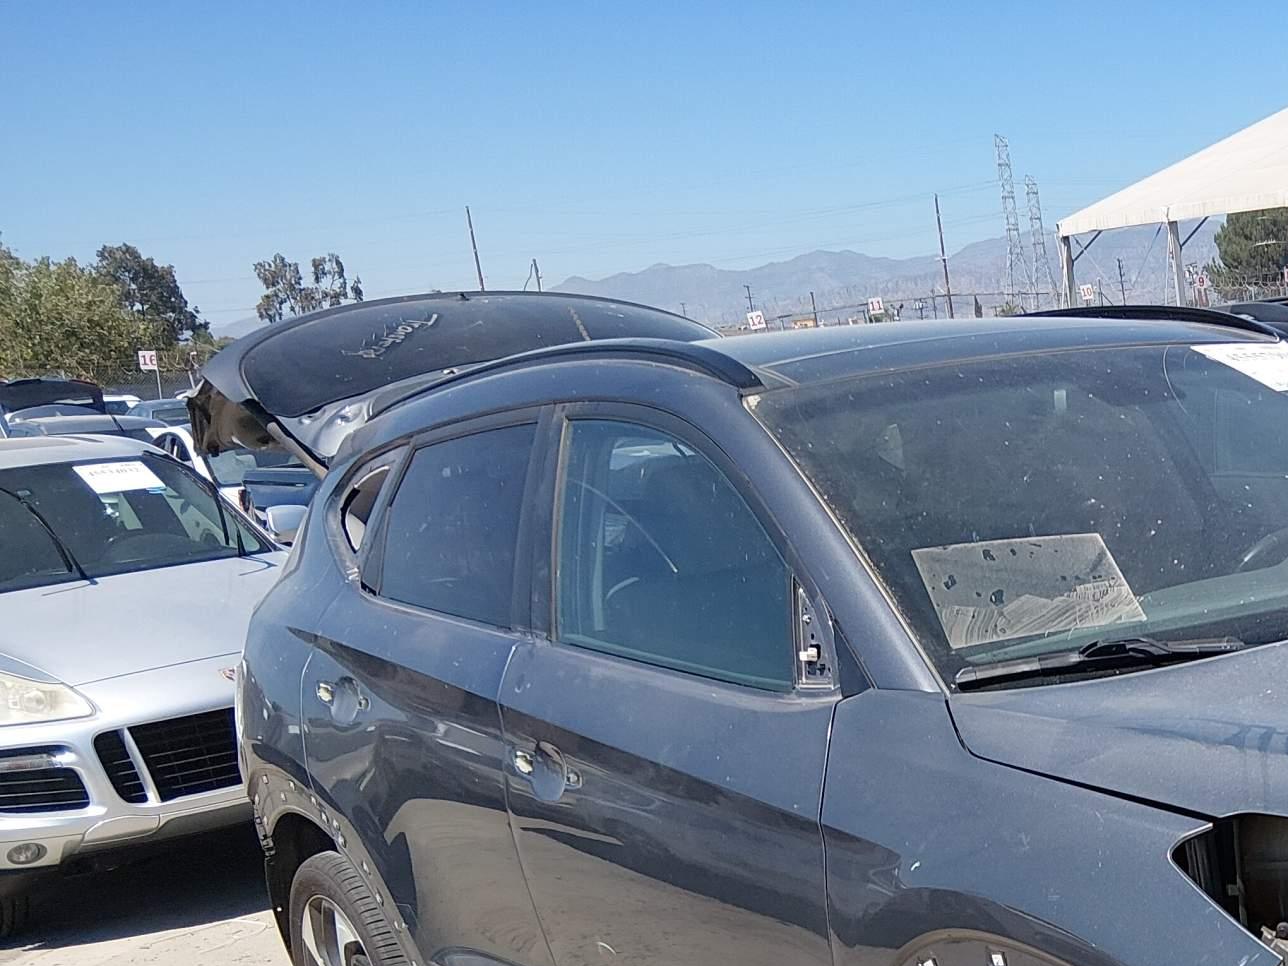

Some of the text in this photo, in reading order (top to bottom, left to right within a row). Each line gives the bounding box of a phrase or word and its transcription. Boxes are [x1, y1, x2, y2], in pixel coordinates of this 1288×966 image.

[1198, 276, 1204, 287] 9
[1082, 287, 1093, 297] 10
[870, 300, 883, 312] 11
[749, 314, 763, 327] 12
[140, 354, 157, 366] 16
